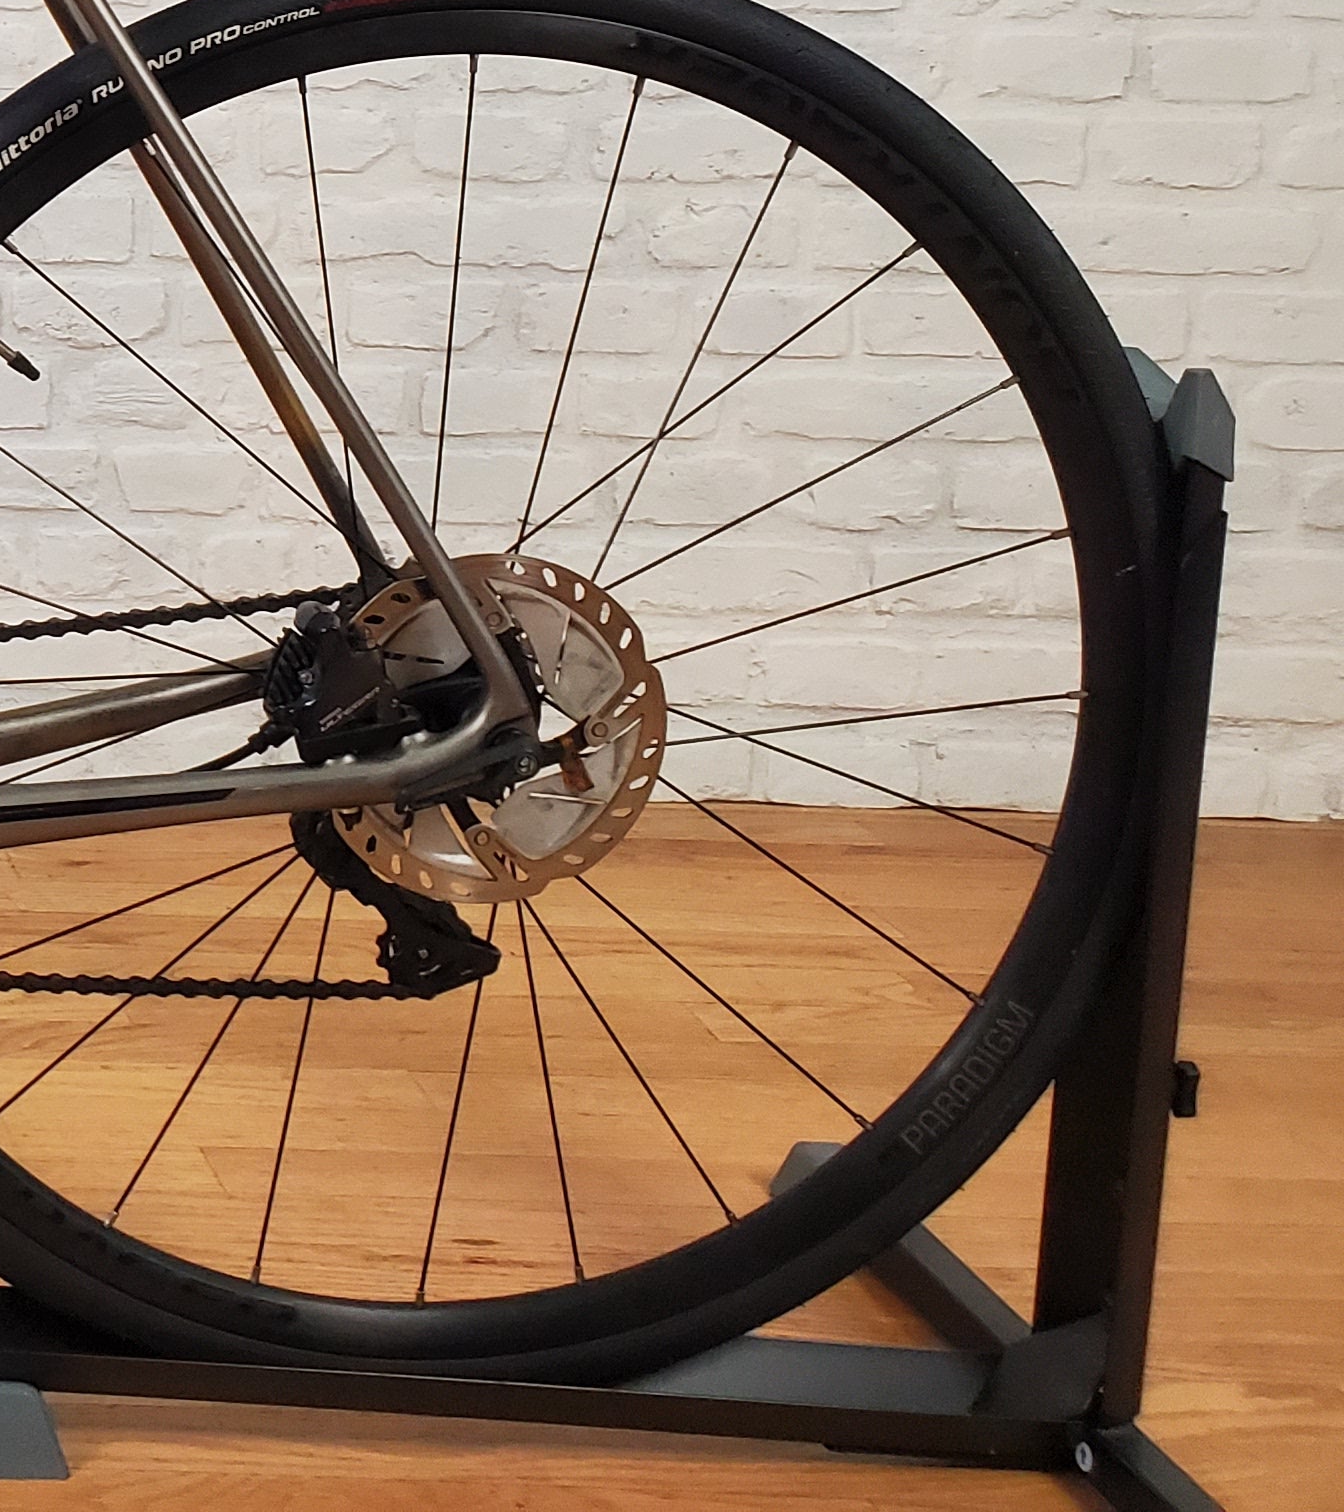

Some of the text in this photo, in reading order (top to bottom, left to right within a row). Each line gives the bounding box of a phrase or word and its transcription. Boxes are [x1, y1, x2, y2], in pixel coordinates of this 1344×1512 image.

[92, 46, 183, 104] RUNO
[190, 25, 241, 56] PRO
[242, 5, 321, 36] CONTROL
[901, 1000, 1034, 1155] PARADIGM
